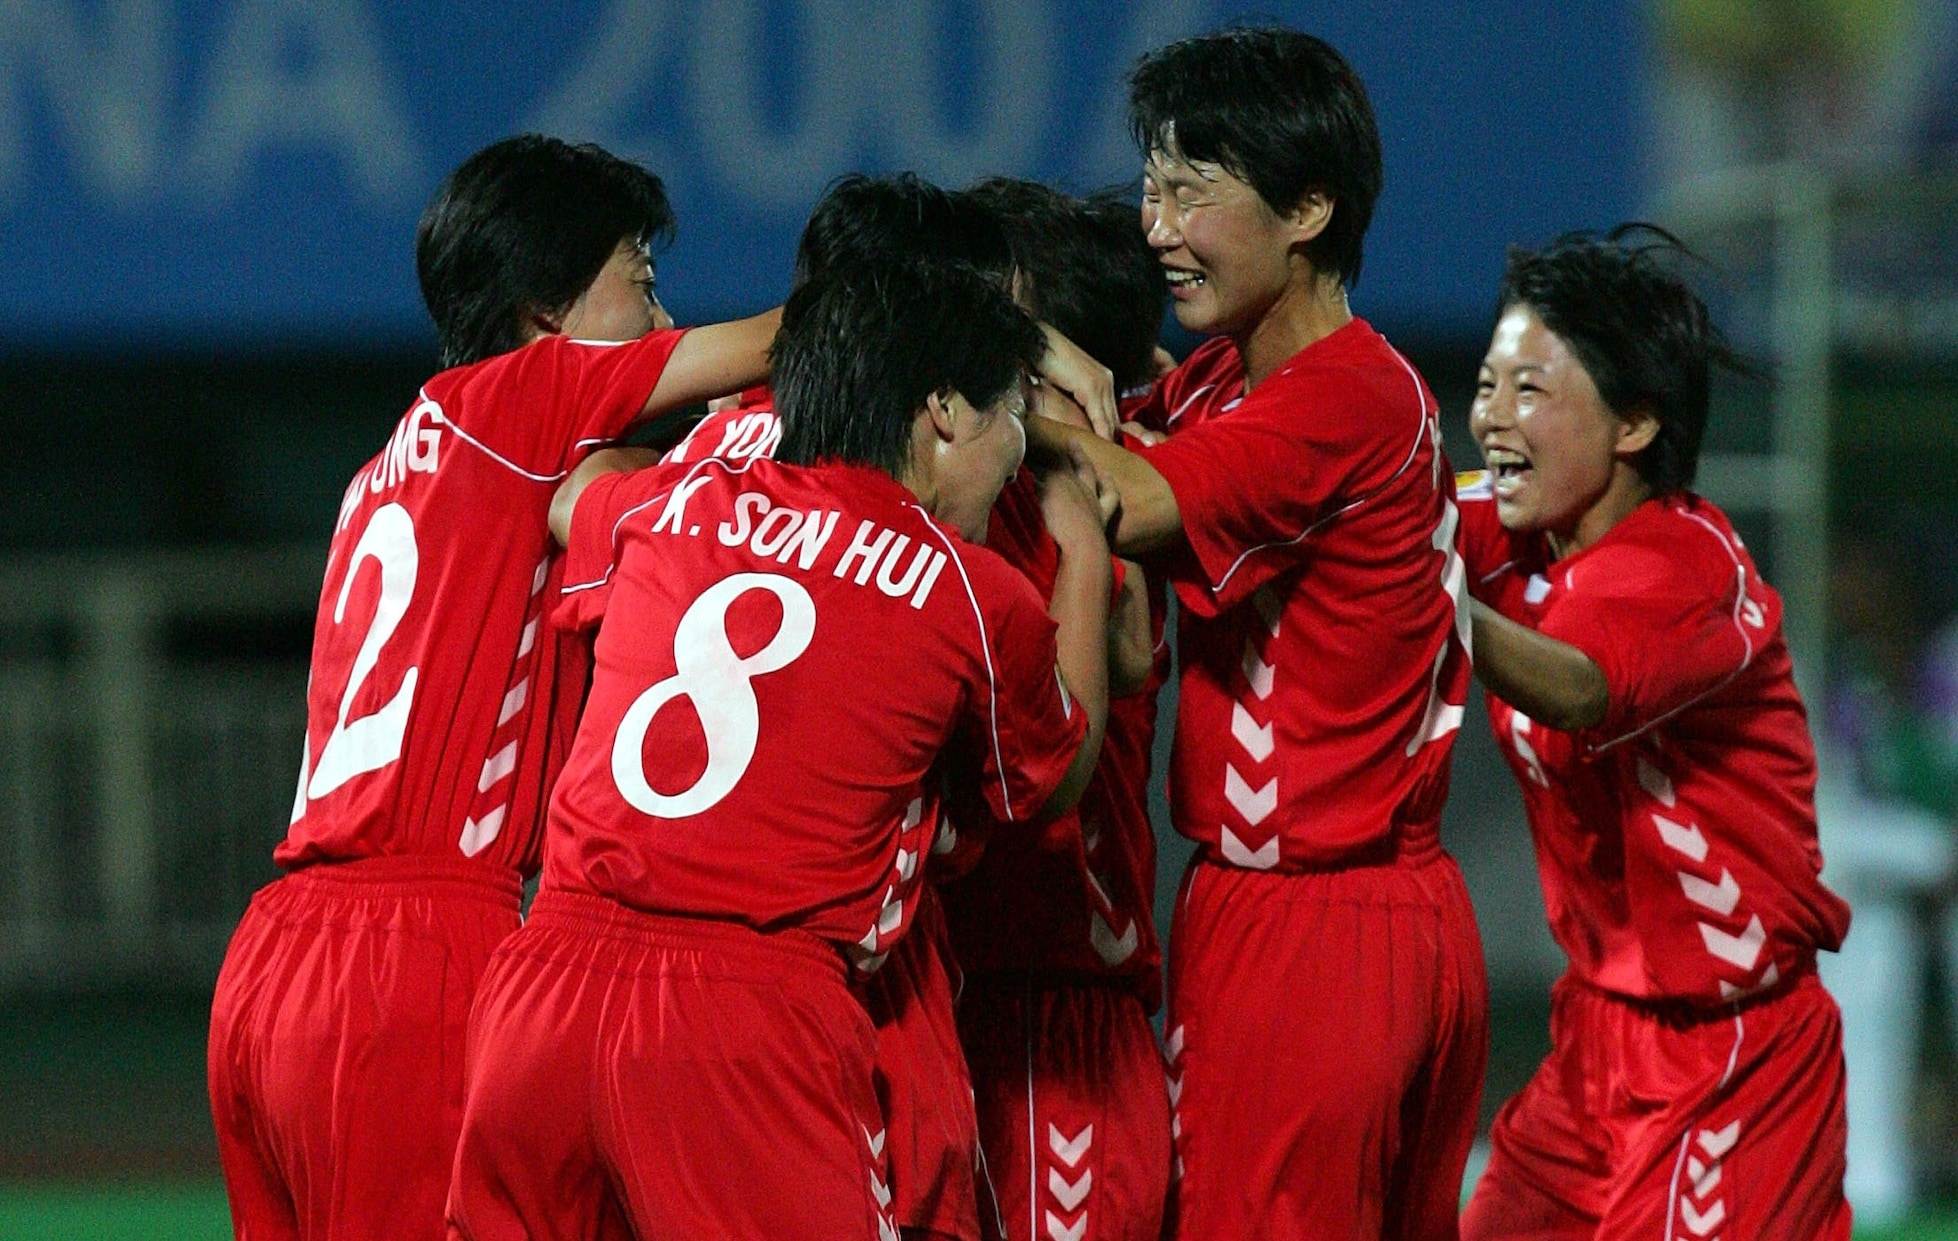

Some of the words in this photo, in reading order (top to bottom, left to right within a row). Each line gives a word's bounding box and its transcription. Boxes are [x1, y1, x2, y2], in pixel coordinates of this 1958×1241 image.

[651, 476, 713, 537] K.
[717, 492, 841, 571] SON
[833, 520, 948, 611] HUI
[611, 572, 817, 820] 8
